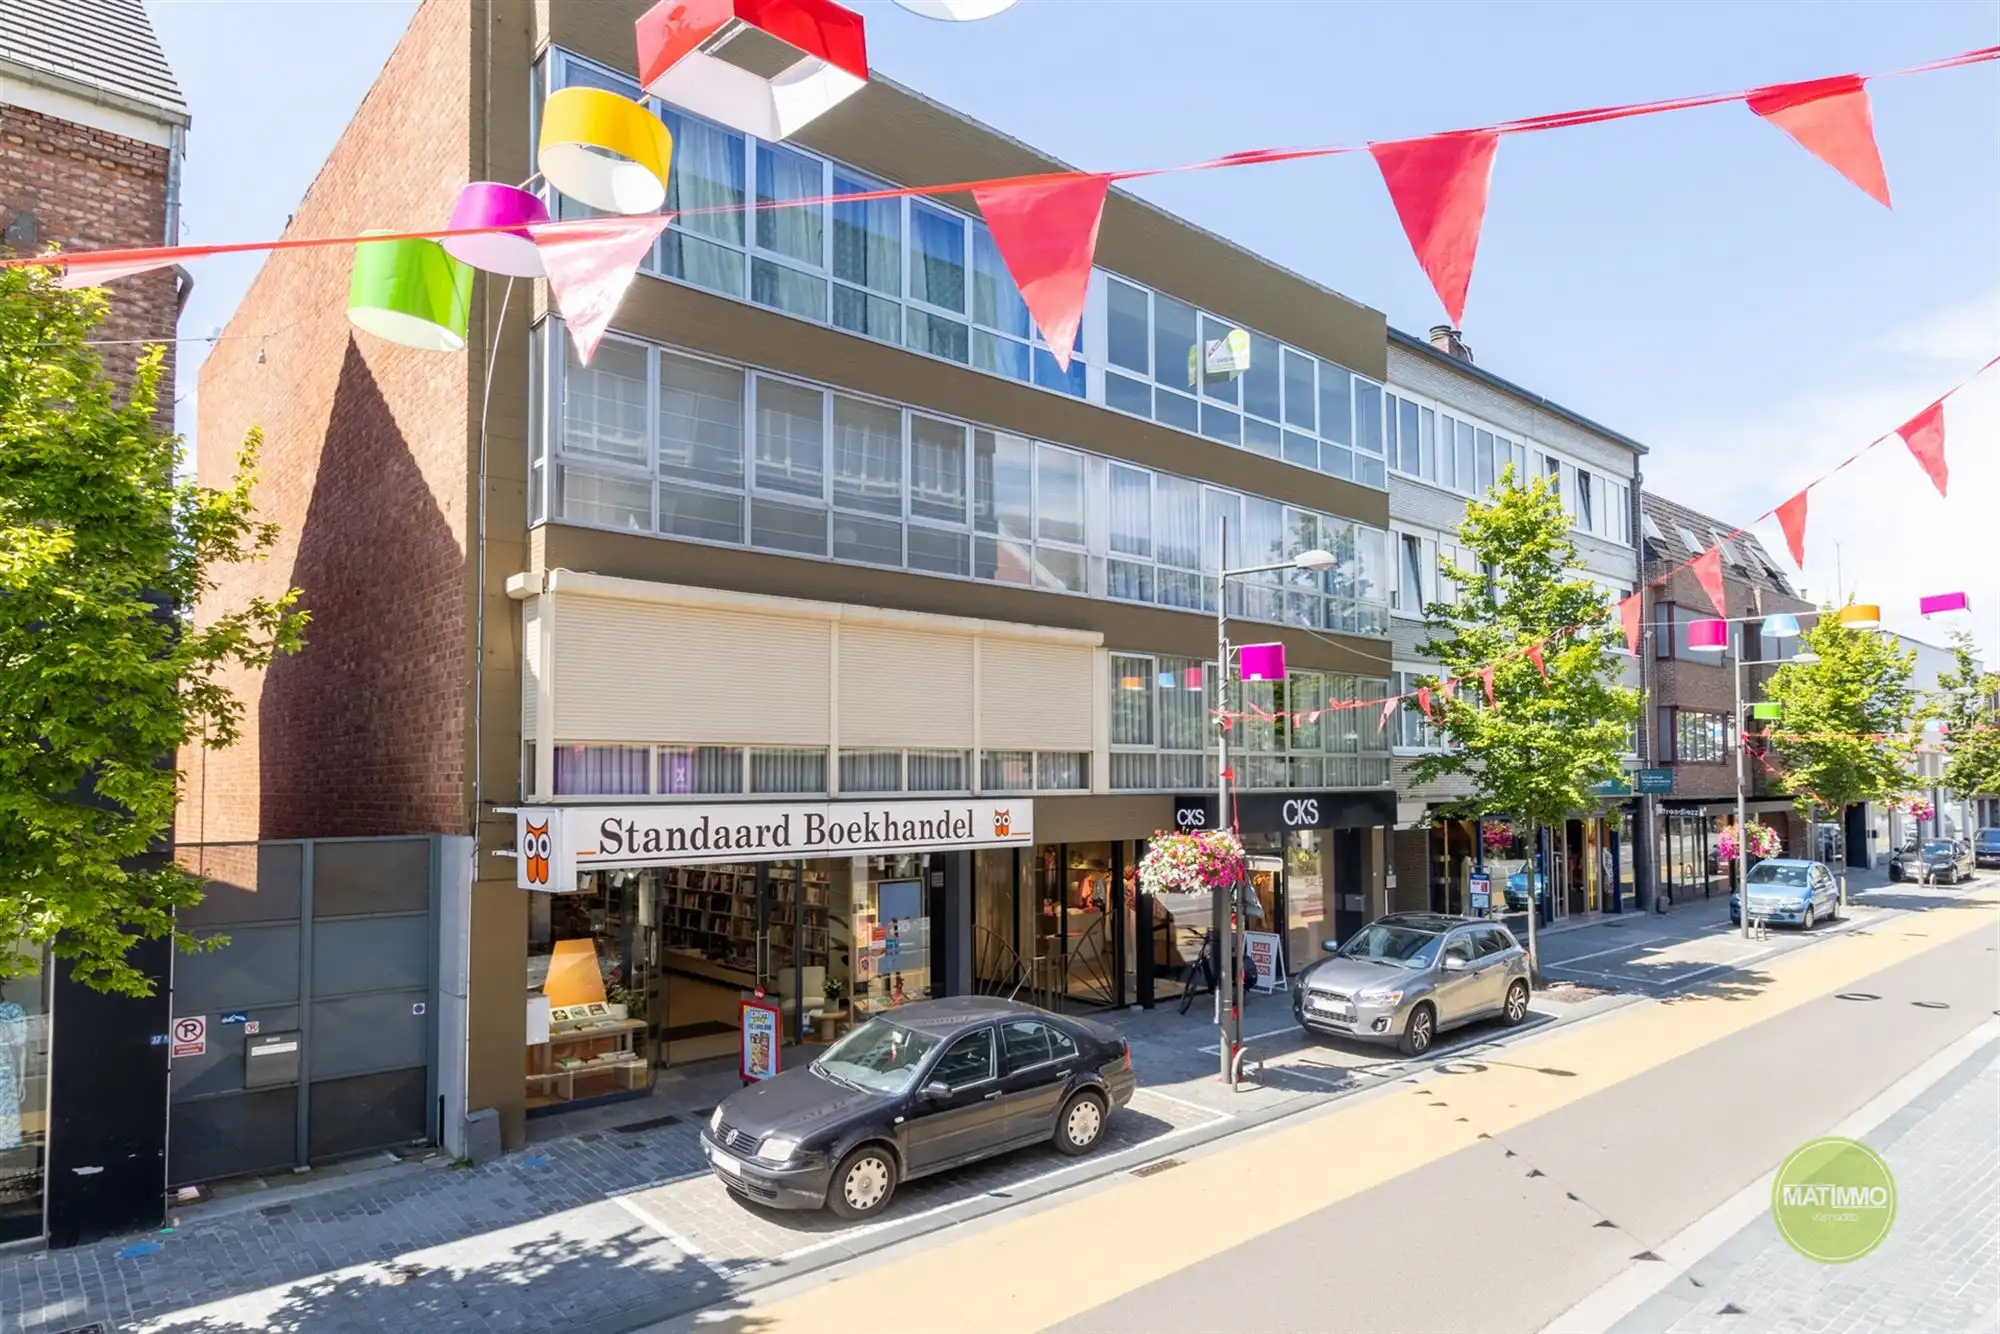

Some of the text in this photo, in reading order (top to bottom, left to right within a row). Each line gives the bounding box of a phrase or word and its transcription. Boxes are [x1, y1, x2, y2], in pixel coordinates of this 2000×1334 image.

[1177, 809, 1205, 825] CKS
[1283, 799, 1319, 825] CKS
[600, 809, 974, 855] Standaard Boekhandel
[1253, 942, 1270, 952] SALE
